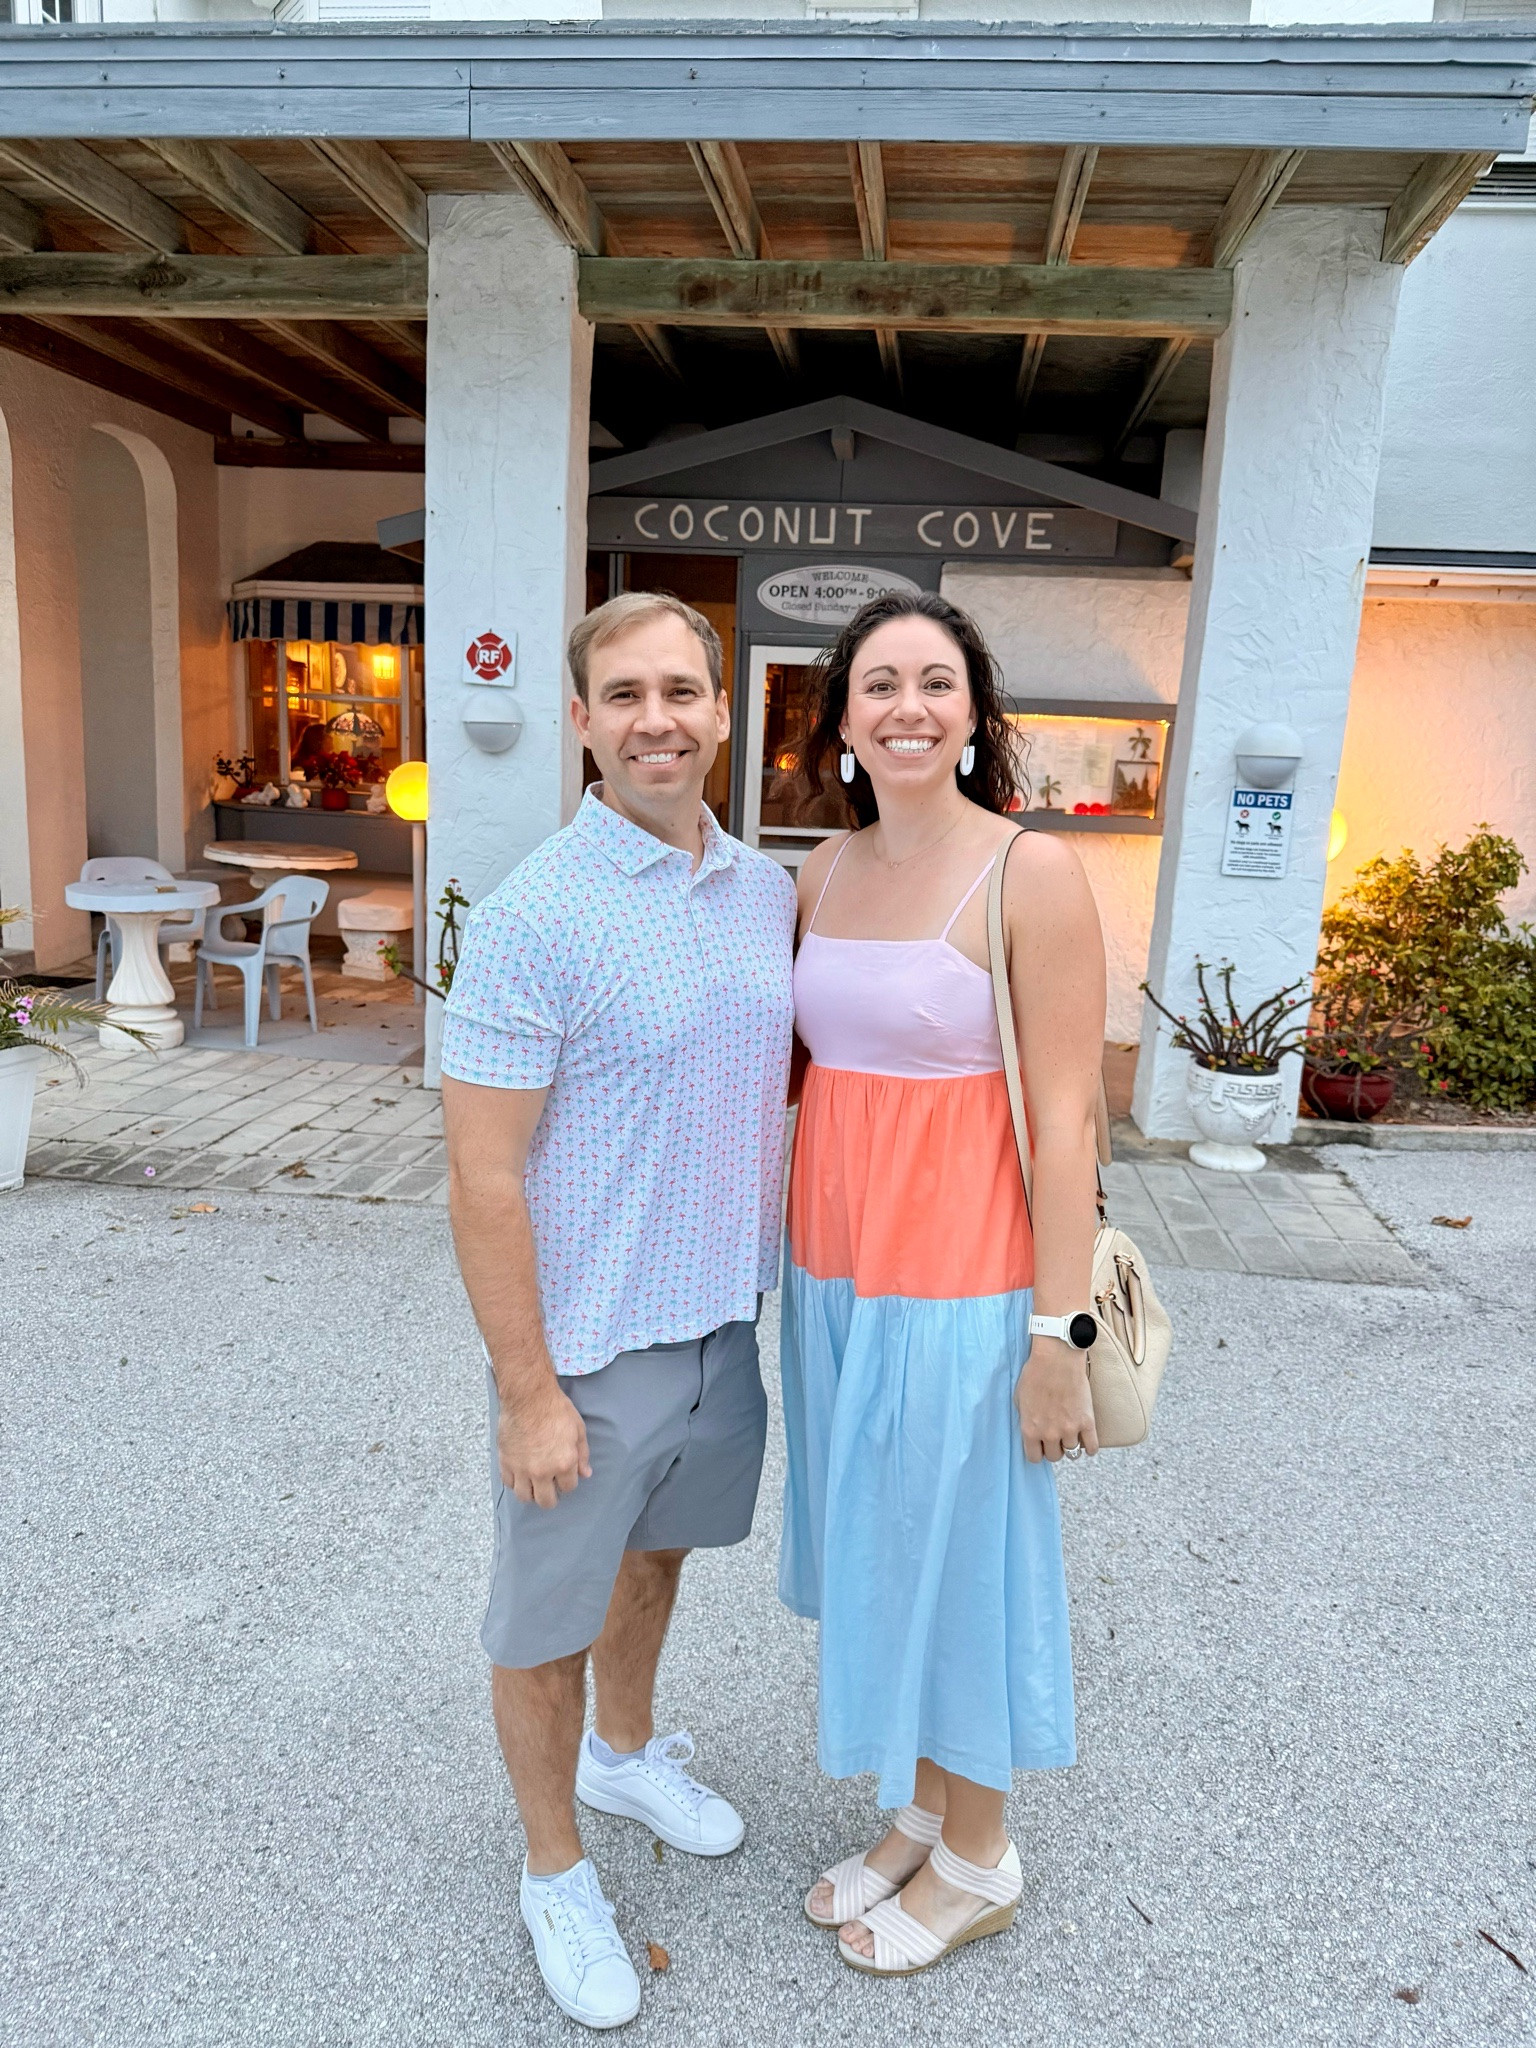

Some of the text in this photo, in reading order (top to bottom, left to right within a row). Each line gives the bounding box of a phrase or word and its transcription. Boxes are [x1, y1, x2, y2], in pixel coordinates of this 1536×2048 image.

[634, 503, 1053, 549] COCONUT COVE
[812, 571, 869, 583] WELCOME
[769, 585, 809, 598] OPEN
[781, 602, 812, 611] Closed
[479, 649, 500, 664] RF
[1237, 793, 1287, 807] NO PETS
